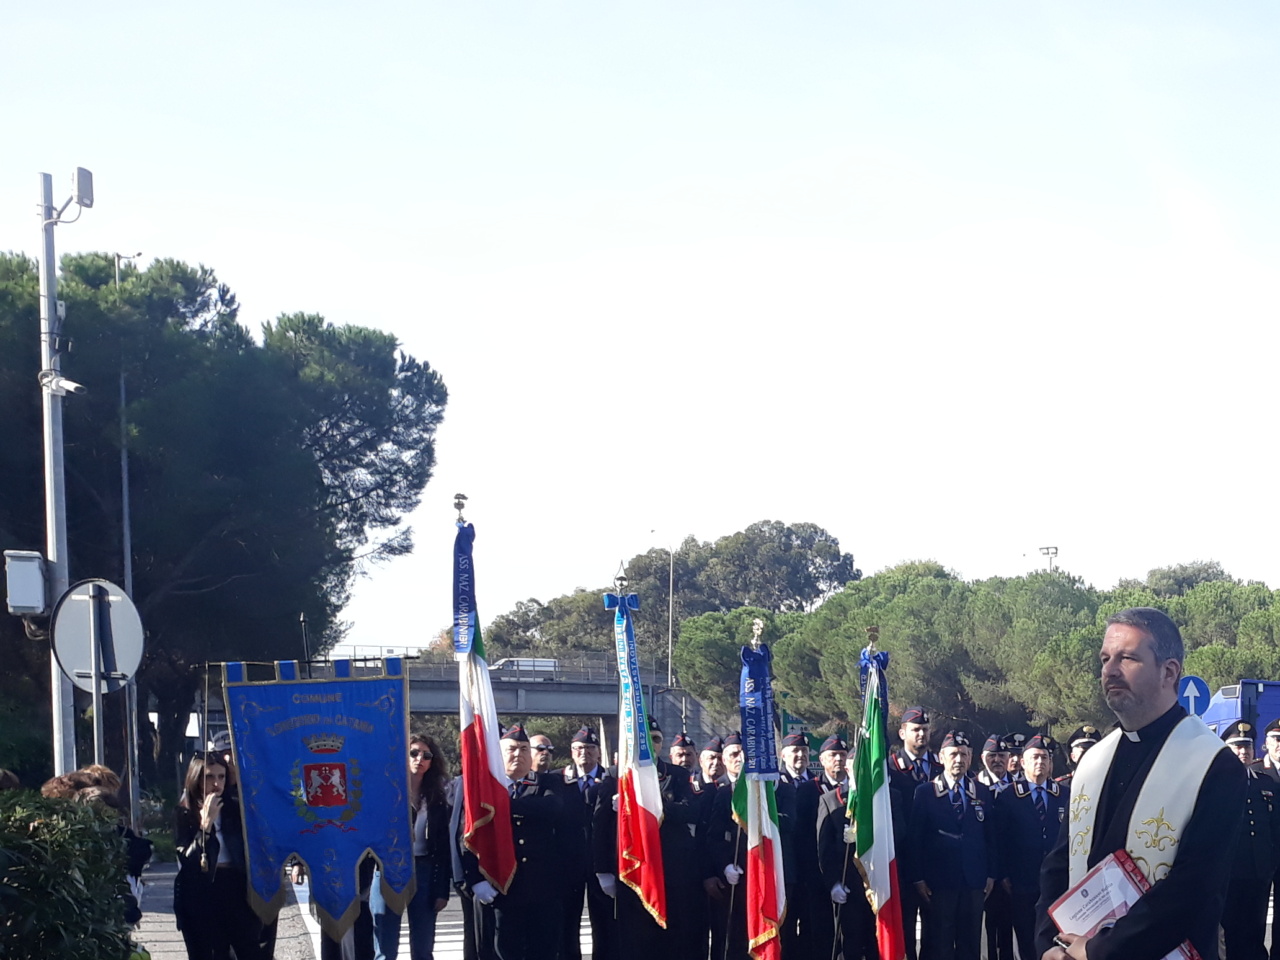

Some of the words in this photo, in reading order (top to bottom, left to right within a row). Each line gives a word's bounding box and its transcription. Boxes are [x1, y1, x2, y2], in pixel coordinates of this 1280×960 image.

[458, 553, 470, 572] ASS.
[458, 595, 470, 648] CARABINIERI
[628, 640, 641, 709] TRECASTAGNI
[292, 693, 343, 704] COMUNE
[637, 713, 644, 723] DI
[746, 718, 756, 769] CARABINIERI
